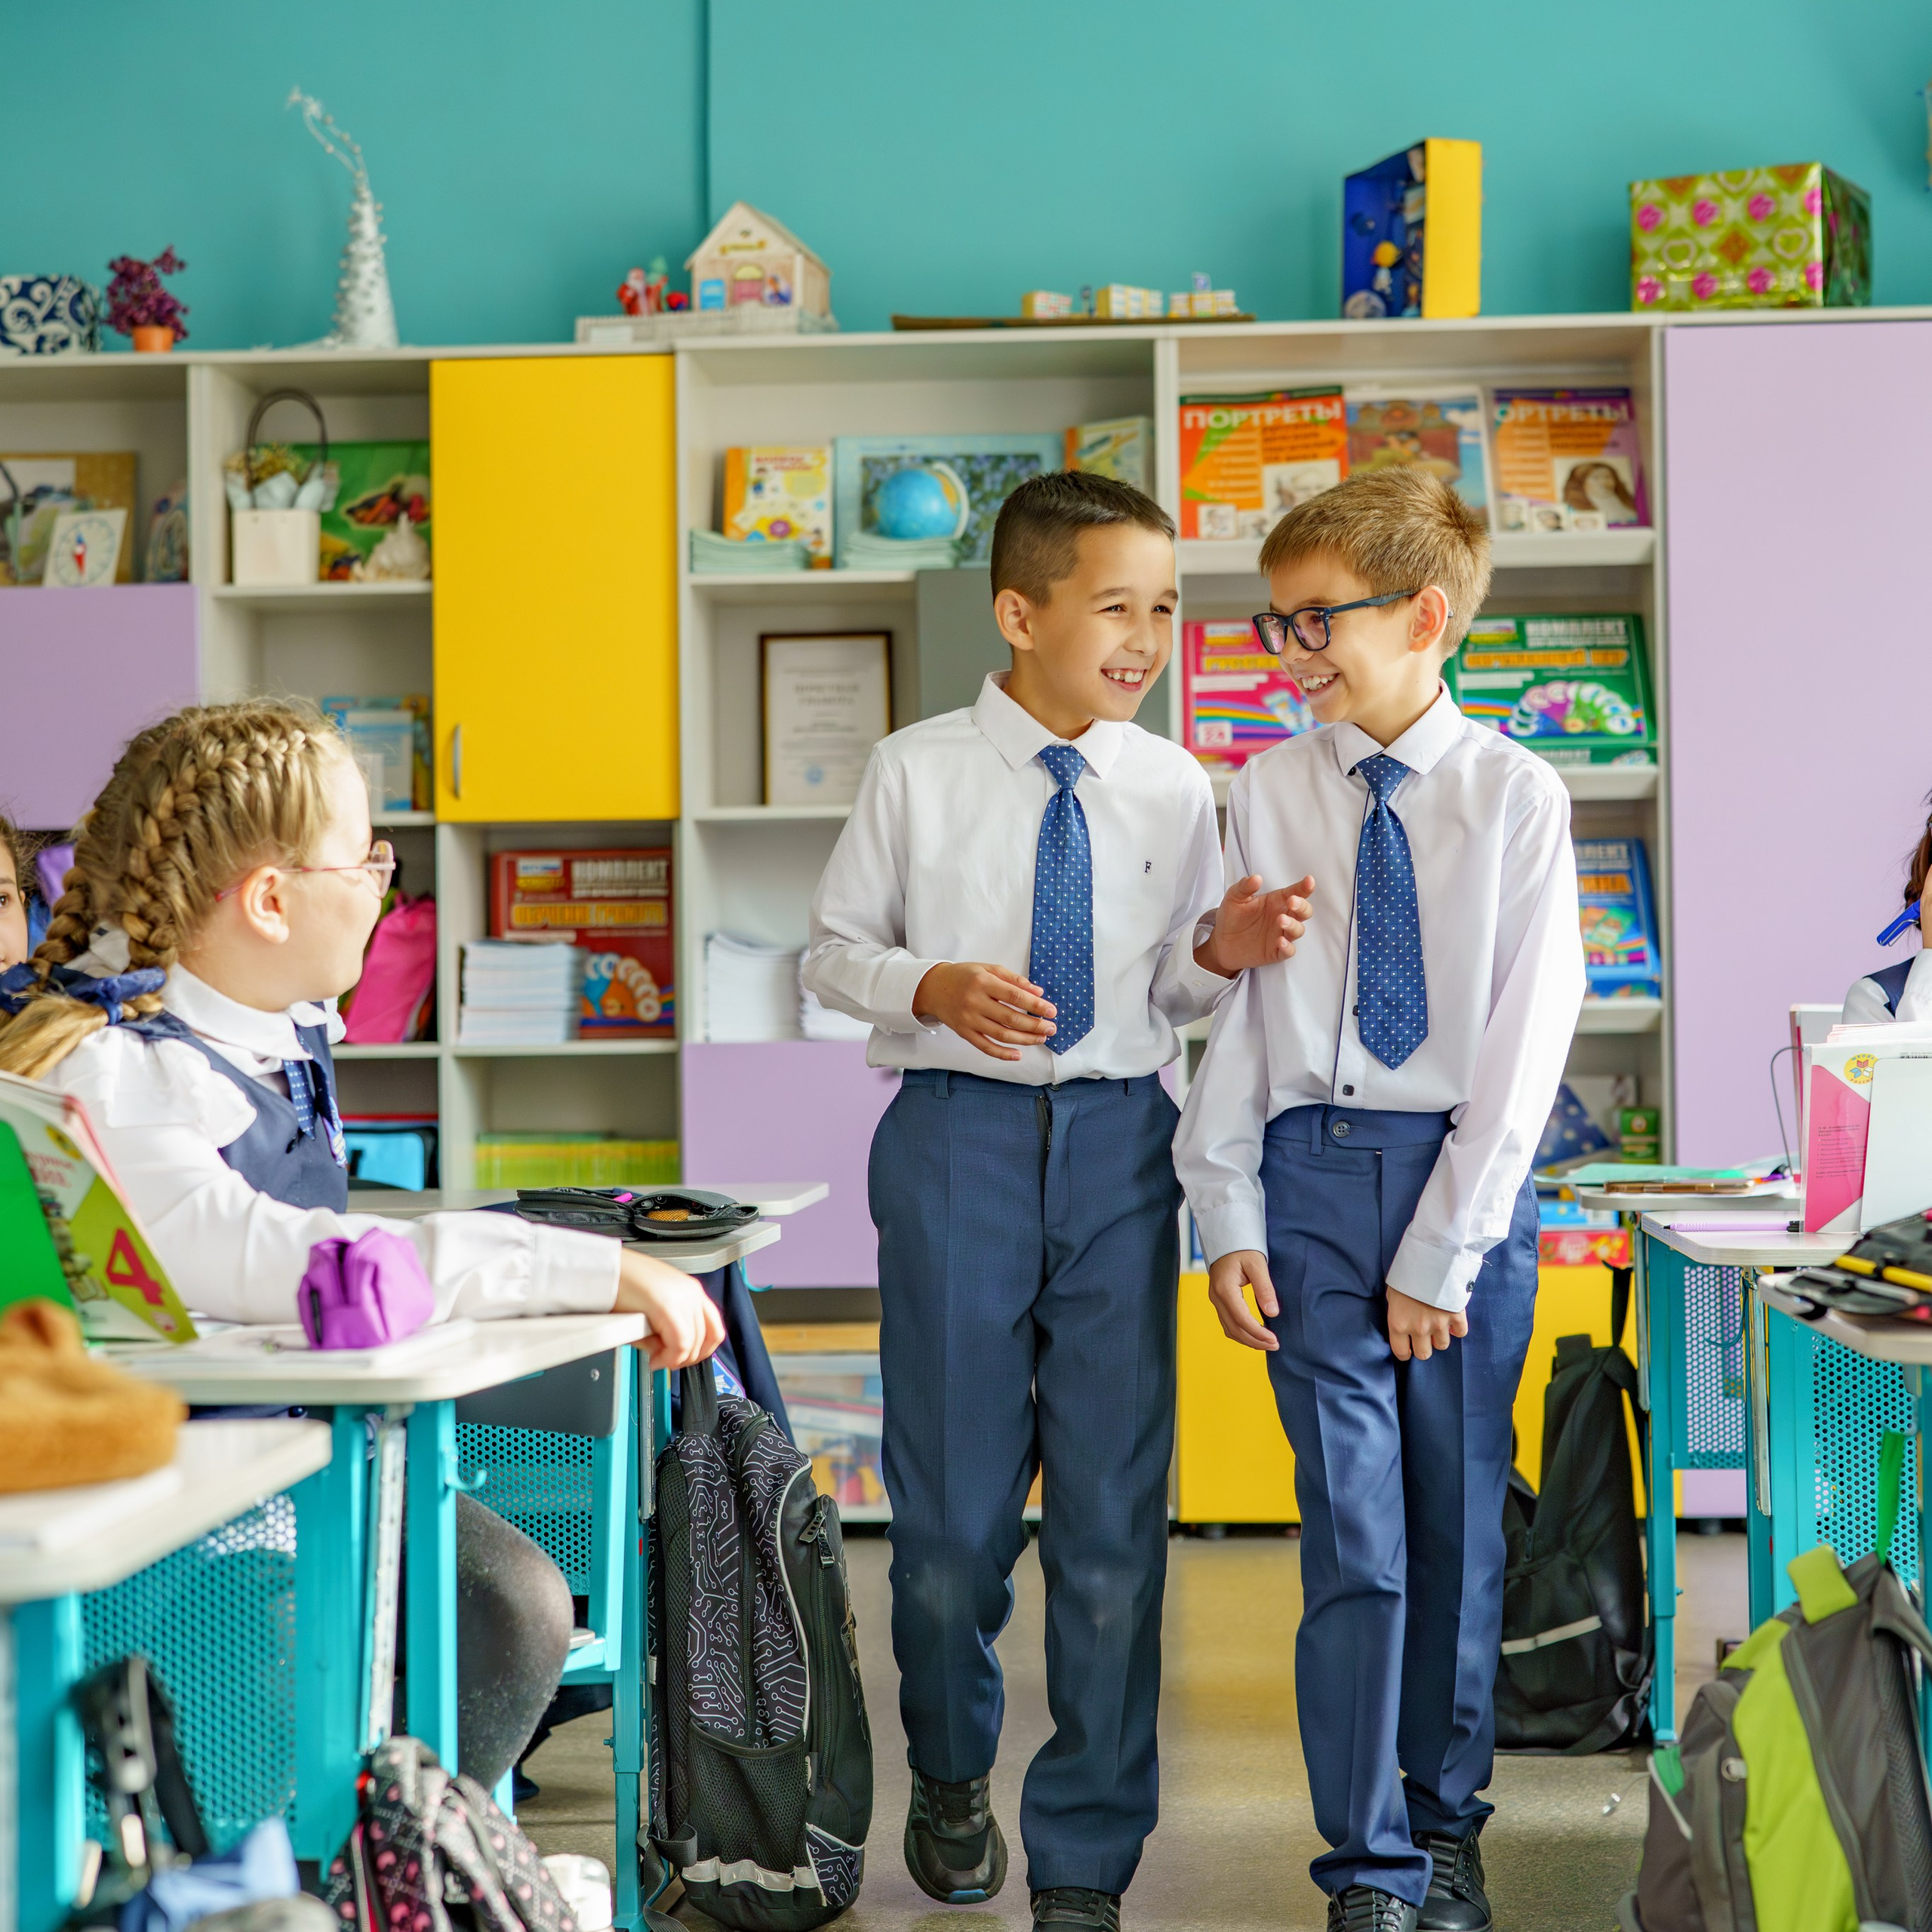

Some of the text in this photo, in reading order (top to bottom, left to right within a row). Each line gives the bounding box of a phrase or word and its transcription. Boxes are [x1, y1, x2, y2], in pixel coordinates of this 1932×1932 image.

[1183, 400, 1341, 429] ПОРТРЕТЫ
[1494, 403, 1629, 423] ОРТРЕТЫ
[571, 860, 667, 882] КОМПЛЕКТ
[1145, 861, 1152, 873] F
[106, 1227, 165, 1306] 4
